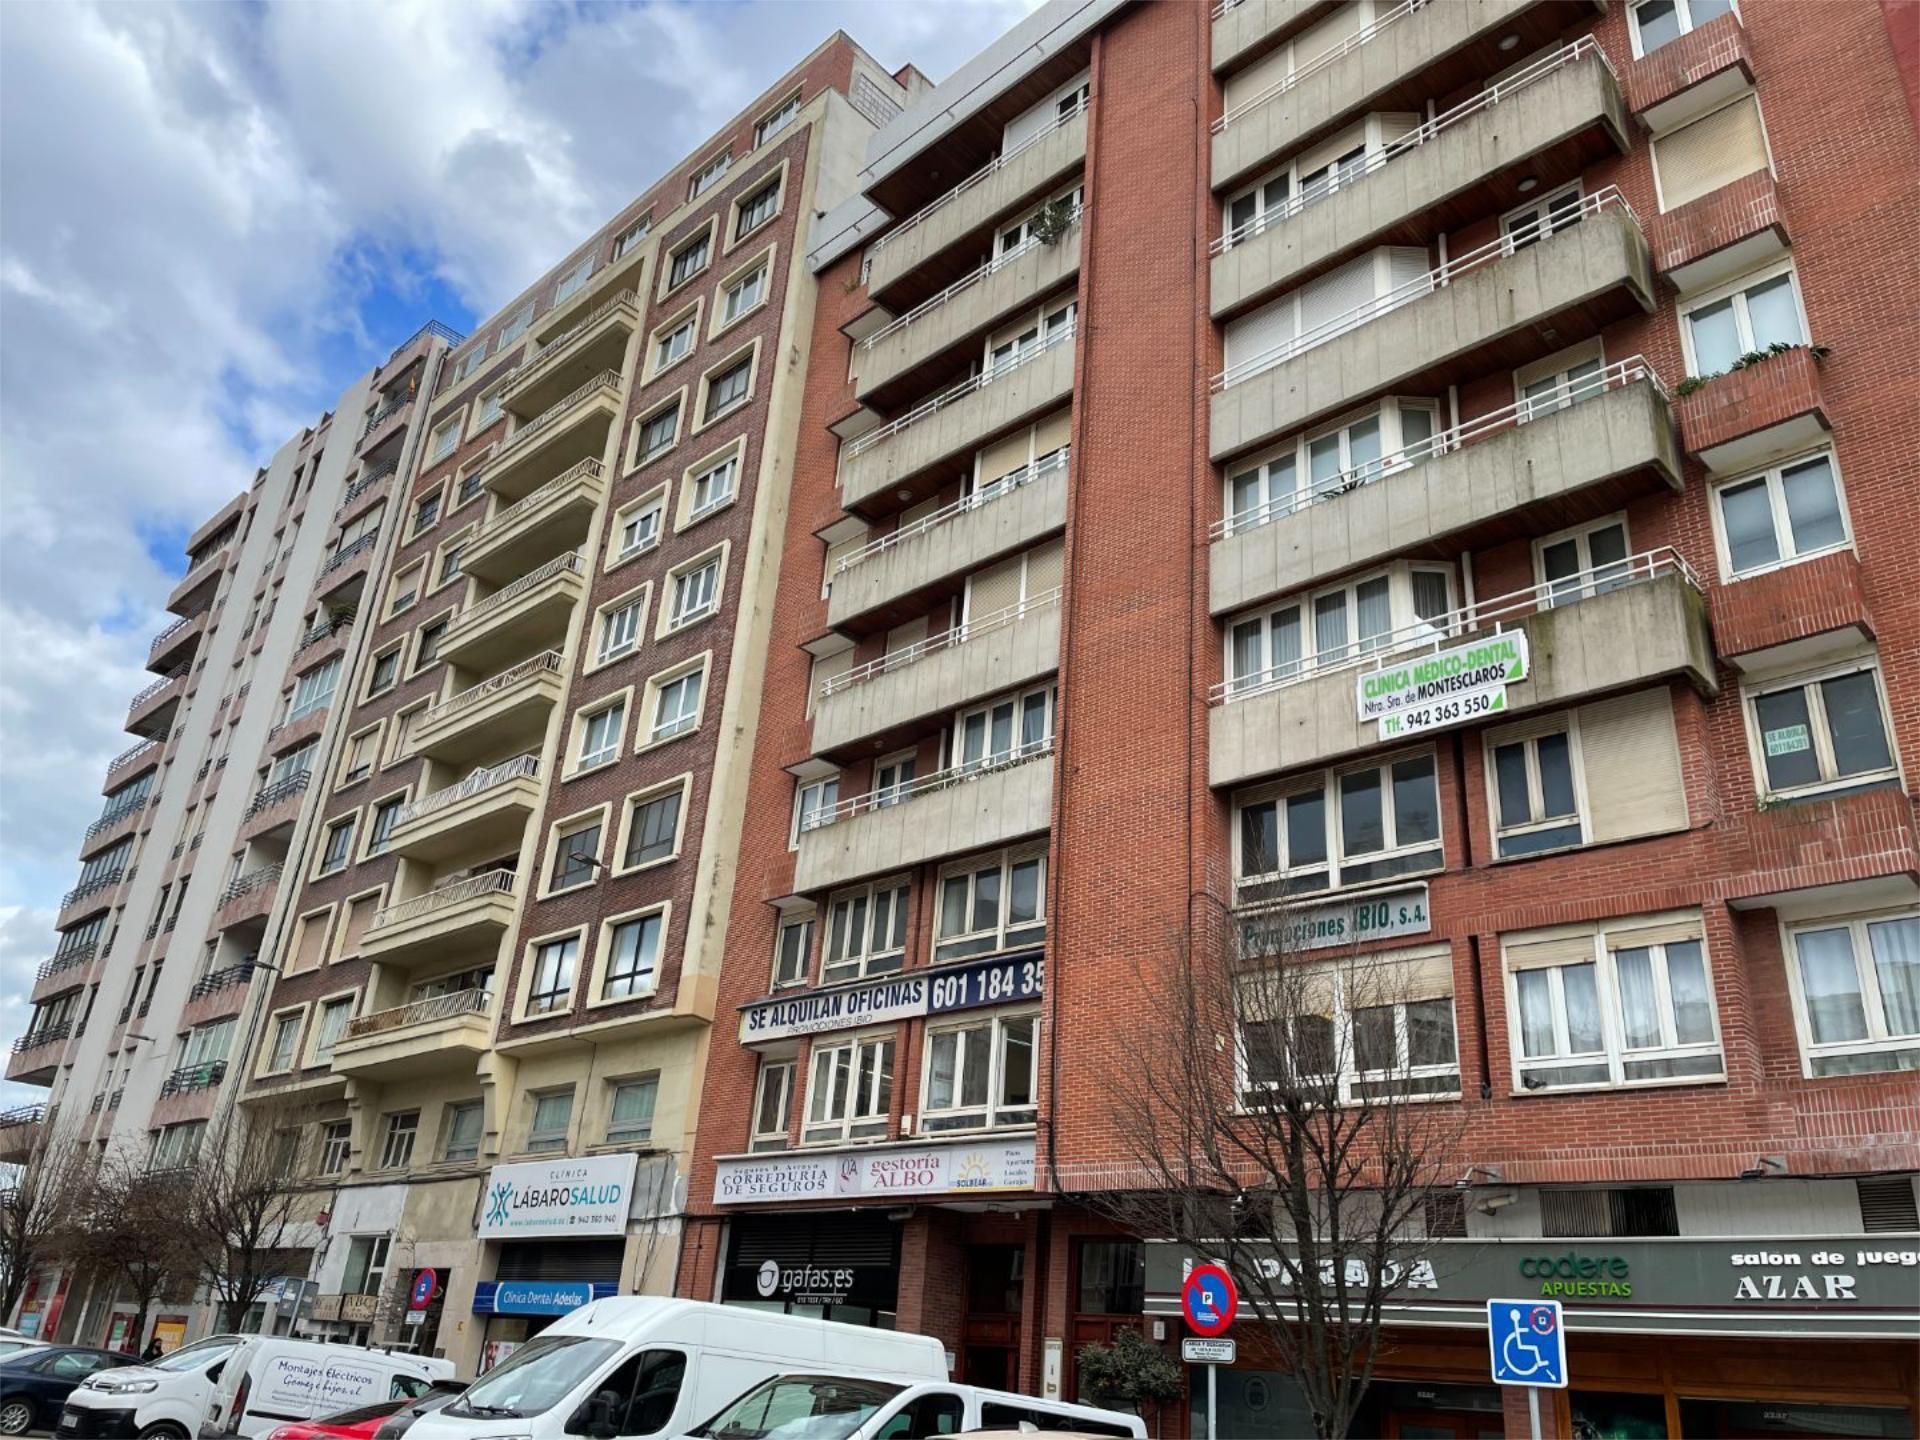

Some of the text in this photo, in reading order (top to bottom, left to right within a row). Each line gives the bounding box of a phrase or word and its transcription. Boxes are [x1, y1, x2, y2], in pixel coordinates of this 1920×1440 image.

[1414, 640, 1516, 684] MÉDICO-DENTAL
[1364, 663, 1505, 715] Ntra. Sra. de MONTESCLAROS
[1384, 694, 1490, 734] Tlf. 942 363 550
[749, 1007, 766, 1030] SE
[770, 995, 842, 1027] ALQUILAN
[848, 981, 923, 1014] OFICINAS
[933, 973, 968, 1009] 601
[977, 965, 1015, 1001] 184
[871, 1153, 940, 1176] gestoría
[724, 1180, 825, 1196] DE SEGUROS
[873, 1170, 934, 1188] ALBO
[1519, 1251, 1629, 1278] codere
[1811, 1251, 1845, 1266] de
[1857, 1251, 1920, 1266] jueg
[783, 1264, 854, 1293] gafas.es
[1540, 1281, 1632, 1297] APUESTAS
[1734, 1275, 1857, 1300] AZAR
[527, 1291, 553, 1304] Dental
[553, 1291, 582, 1306] Adeslas
[278, 1360, 323, 1378] Montajes
